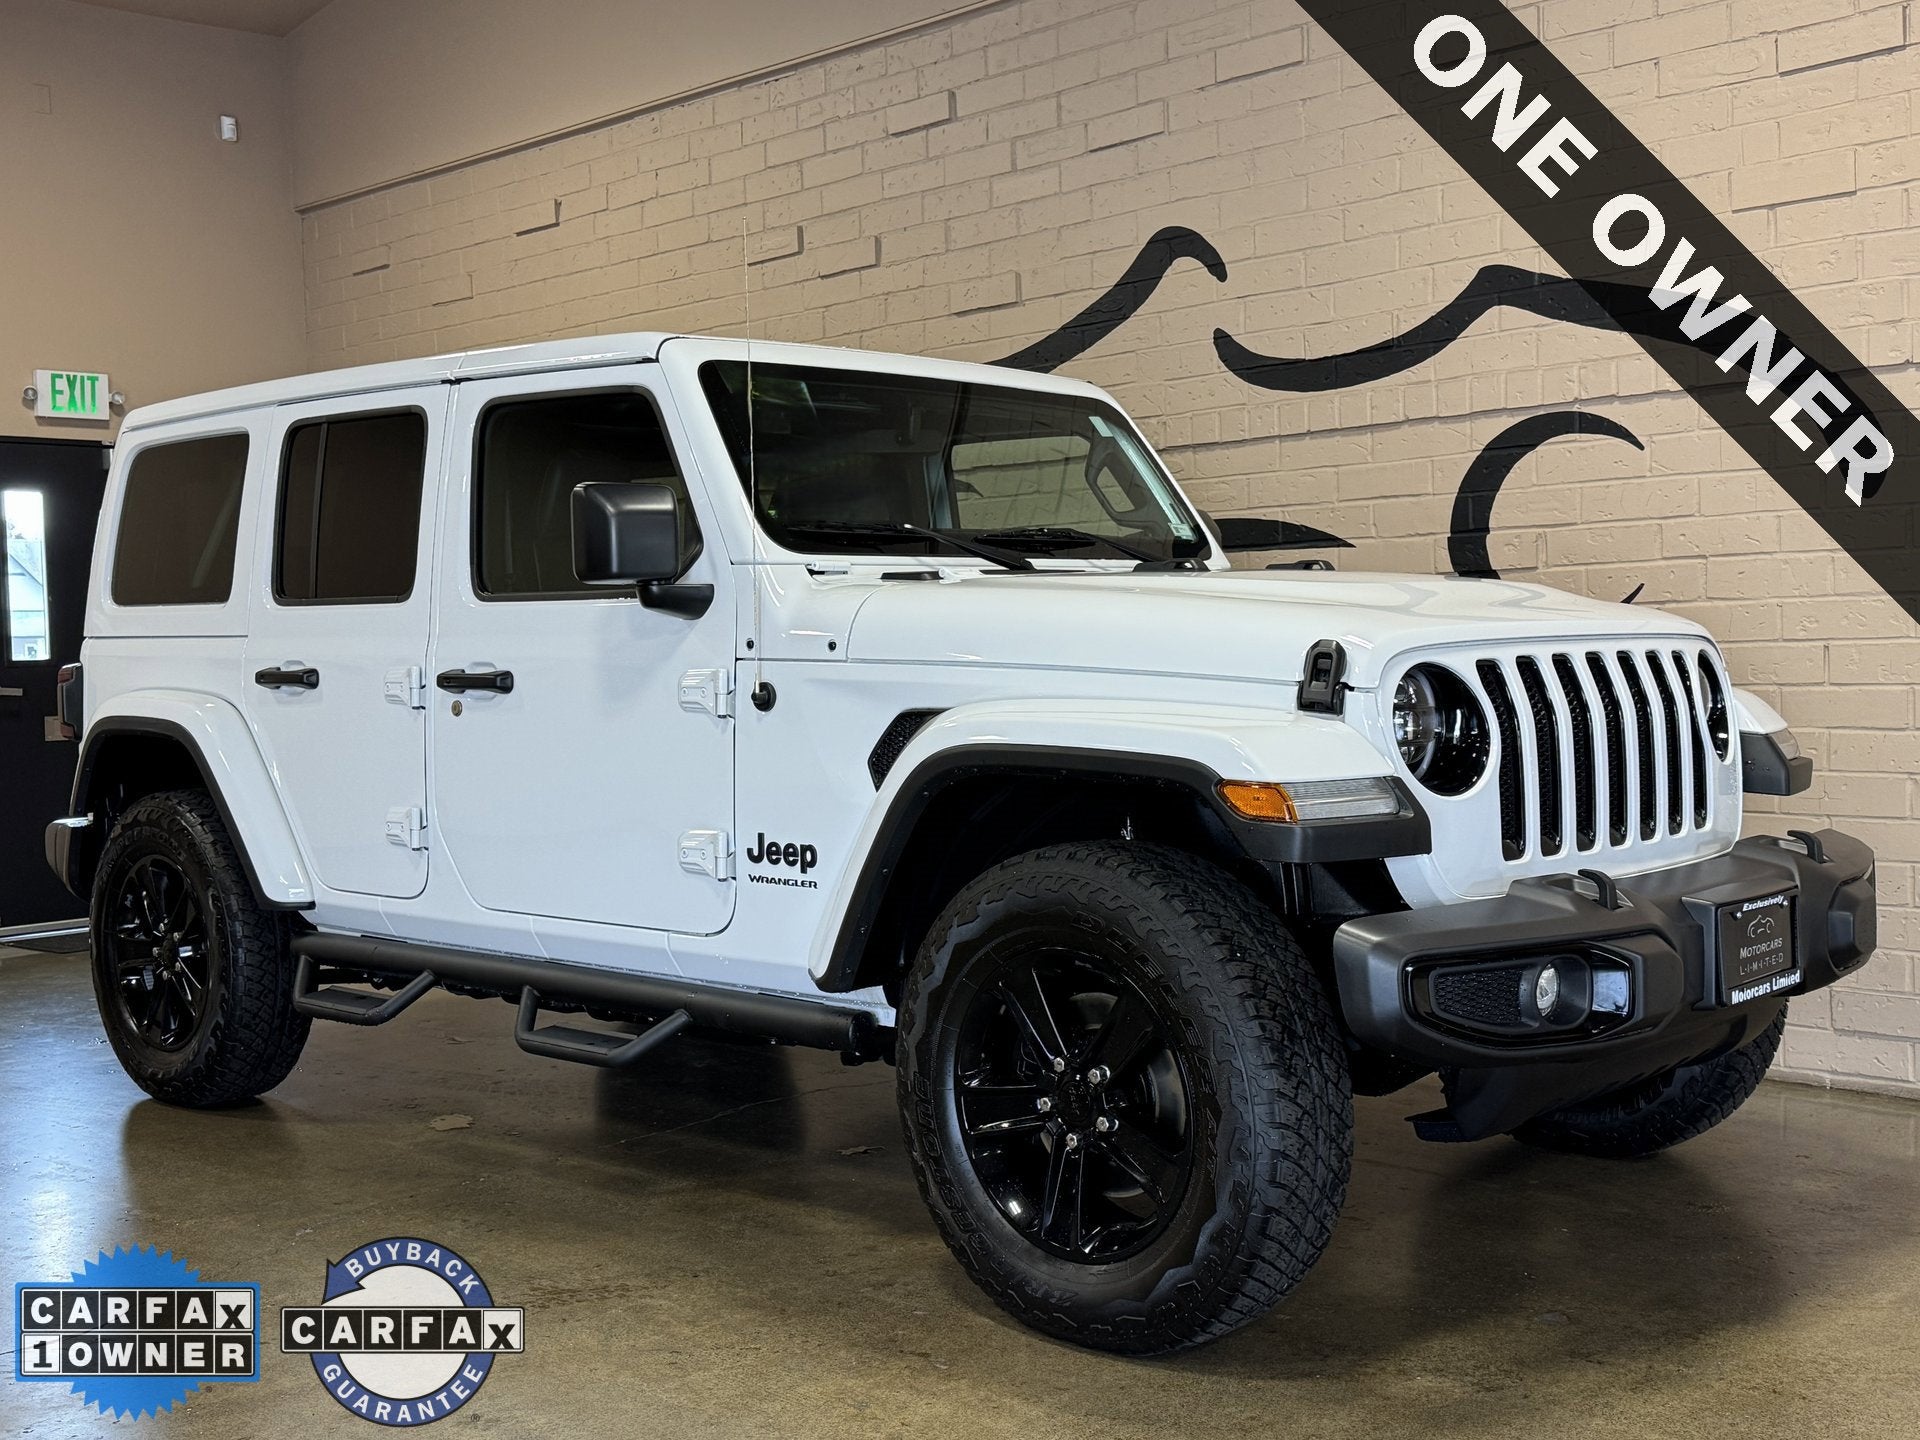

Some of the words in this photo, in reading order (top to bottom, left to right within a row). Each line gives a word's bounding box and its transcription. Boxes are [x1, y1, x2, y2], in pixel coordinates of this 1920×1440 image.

[50, 373, 99, 414] EXIT
[746, 832, 818, 875] Jeep
[748, 873, 818, 889] WRANGLER
[1742, 895, 1784, 911] Exclusively
[1740, 938, 1783, 959] MOTORCARS
[1731, 983, 1772, 1005] Motorcars
[1772, 969, 1800, 991] Limited
